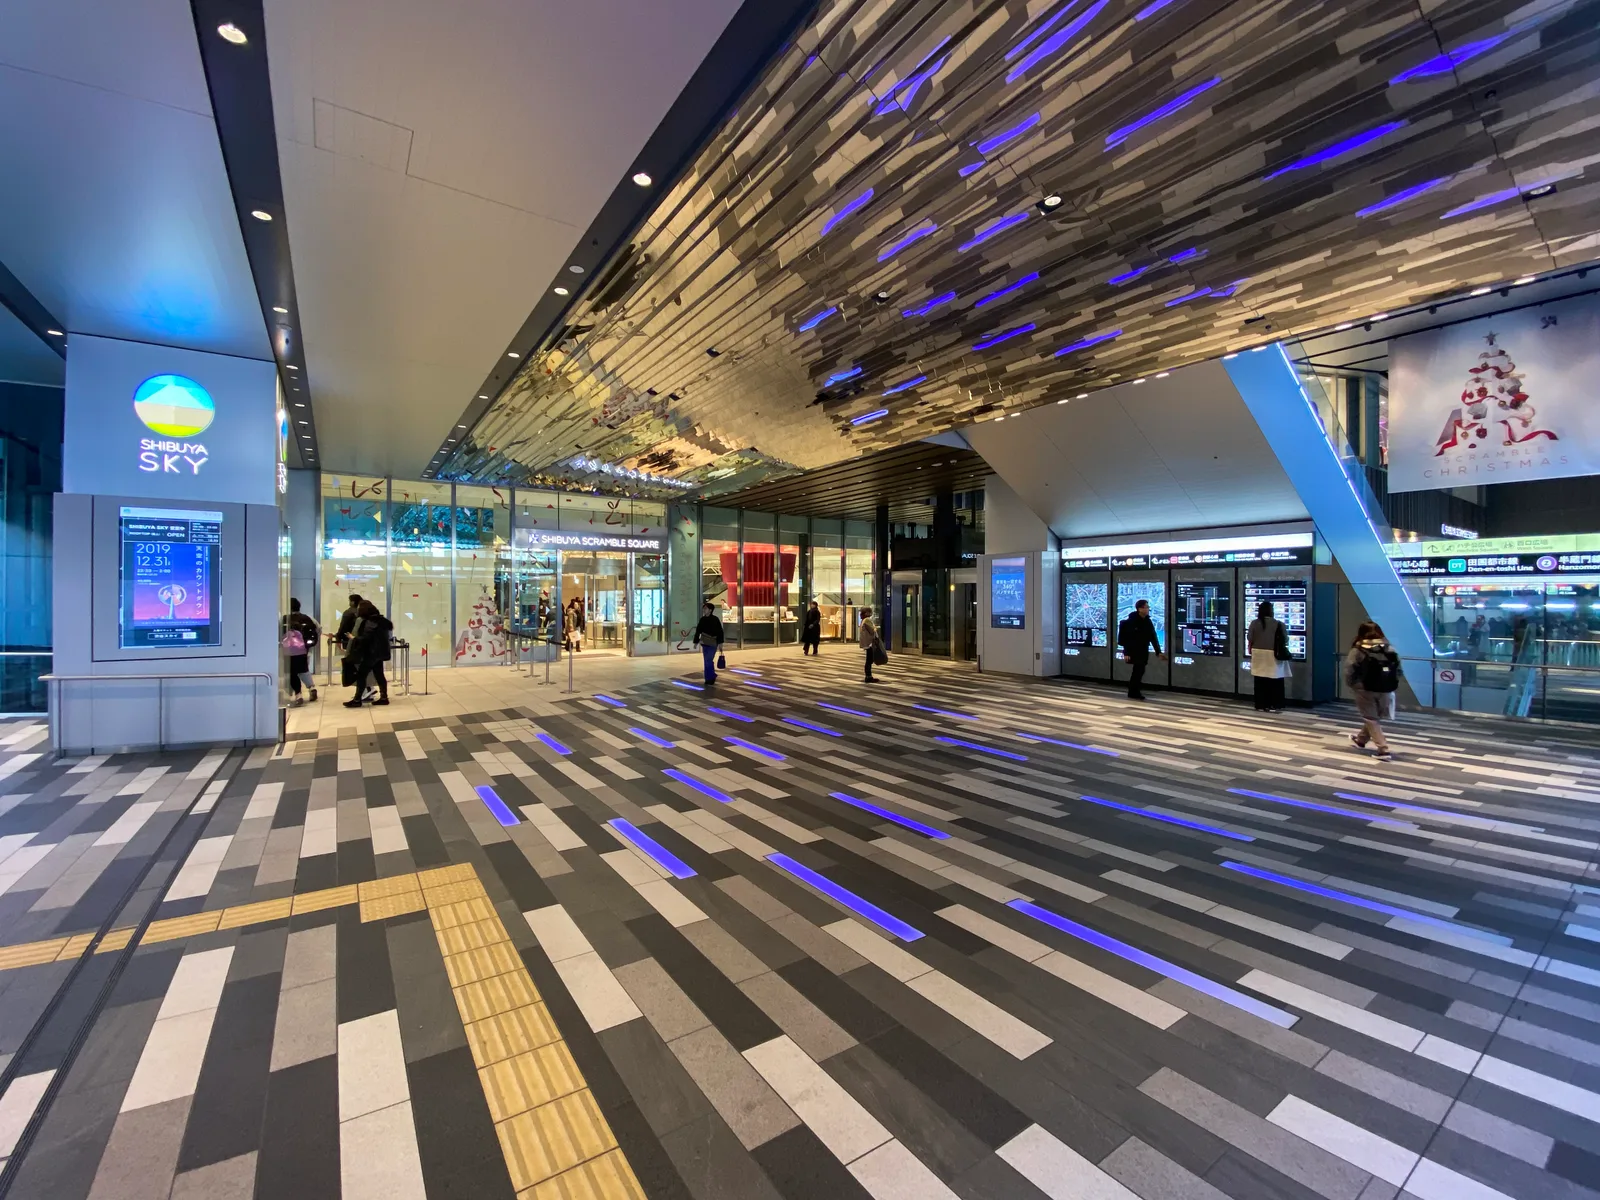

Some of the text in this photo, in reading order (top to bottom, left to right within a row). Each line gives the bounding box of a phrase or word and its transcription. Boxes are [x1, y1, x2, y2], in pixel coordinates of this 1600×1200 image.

[140, 438, 208, 455] SHIBUYA
[1444, 446, 1545, 464] SCRAMBLE
[139, 451, 209, 476] SKY
[1424, 456, 1568, 479] CHRISTMAS
[136, 543, 171, 554] 2019
[542, 534, 660, 549] SHIBUYA SCRAMBLE SQUARE
[136, 556, 168, 566] 12.31
[1467, 557, 1519, 566] 田園都市線
